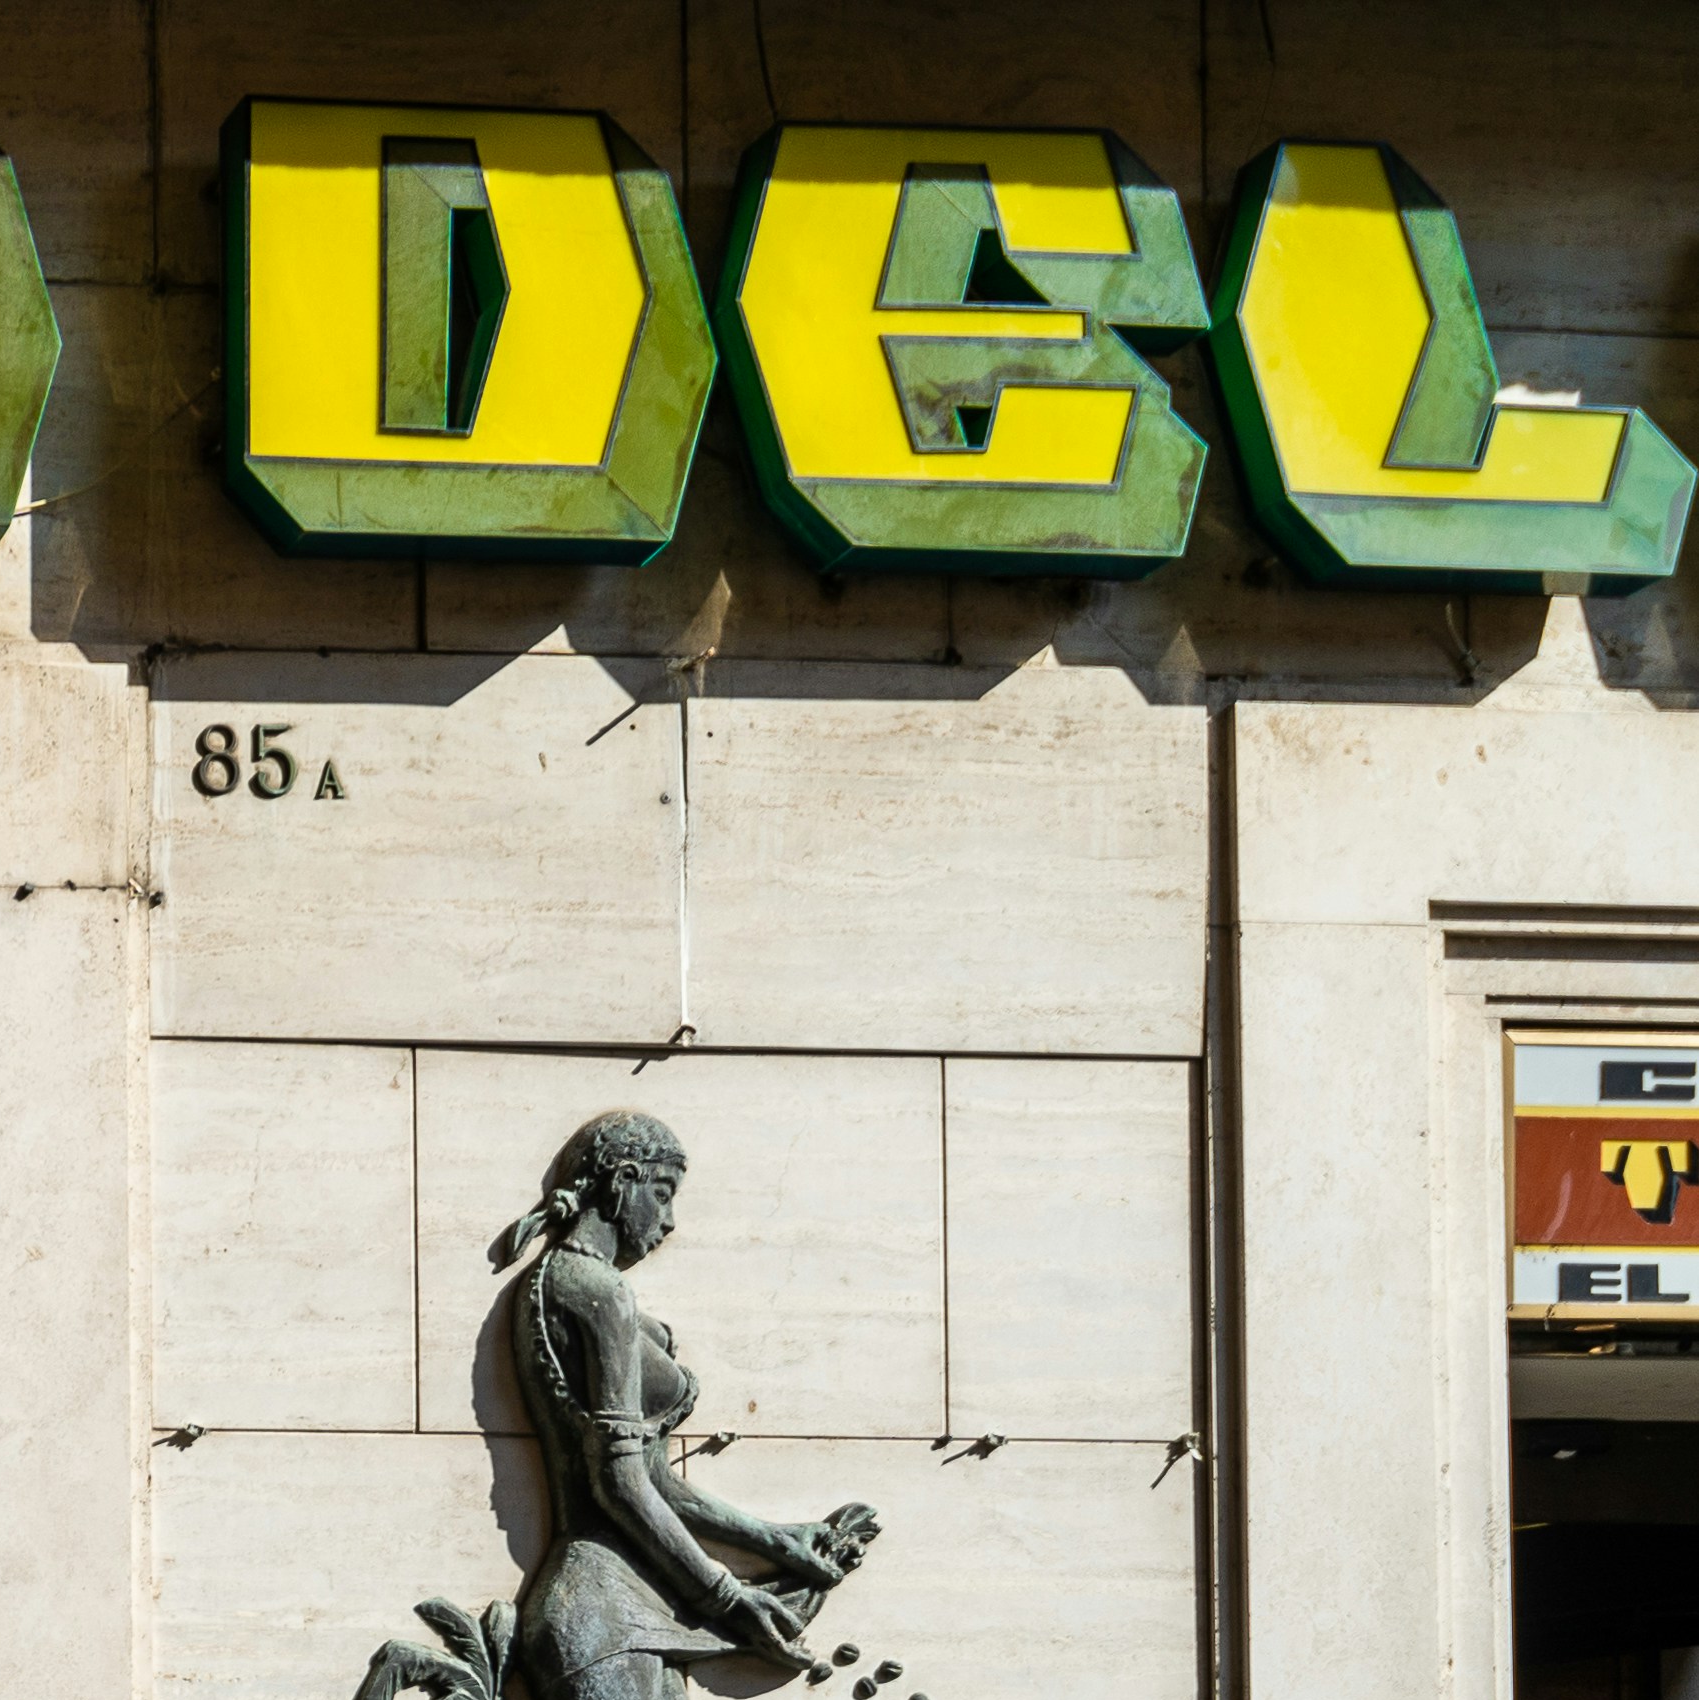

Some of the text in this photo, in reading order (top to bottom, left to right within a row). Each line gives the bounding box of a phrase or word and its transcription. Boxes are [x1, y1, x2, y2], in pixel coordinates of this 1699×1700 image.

[243, 98, 1641, 515] DEL
[191, 723, 346, 801] 85 A
[1557, 1262, 1691, 1304] EL
